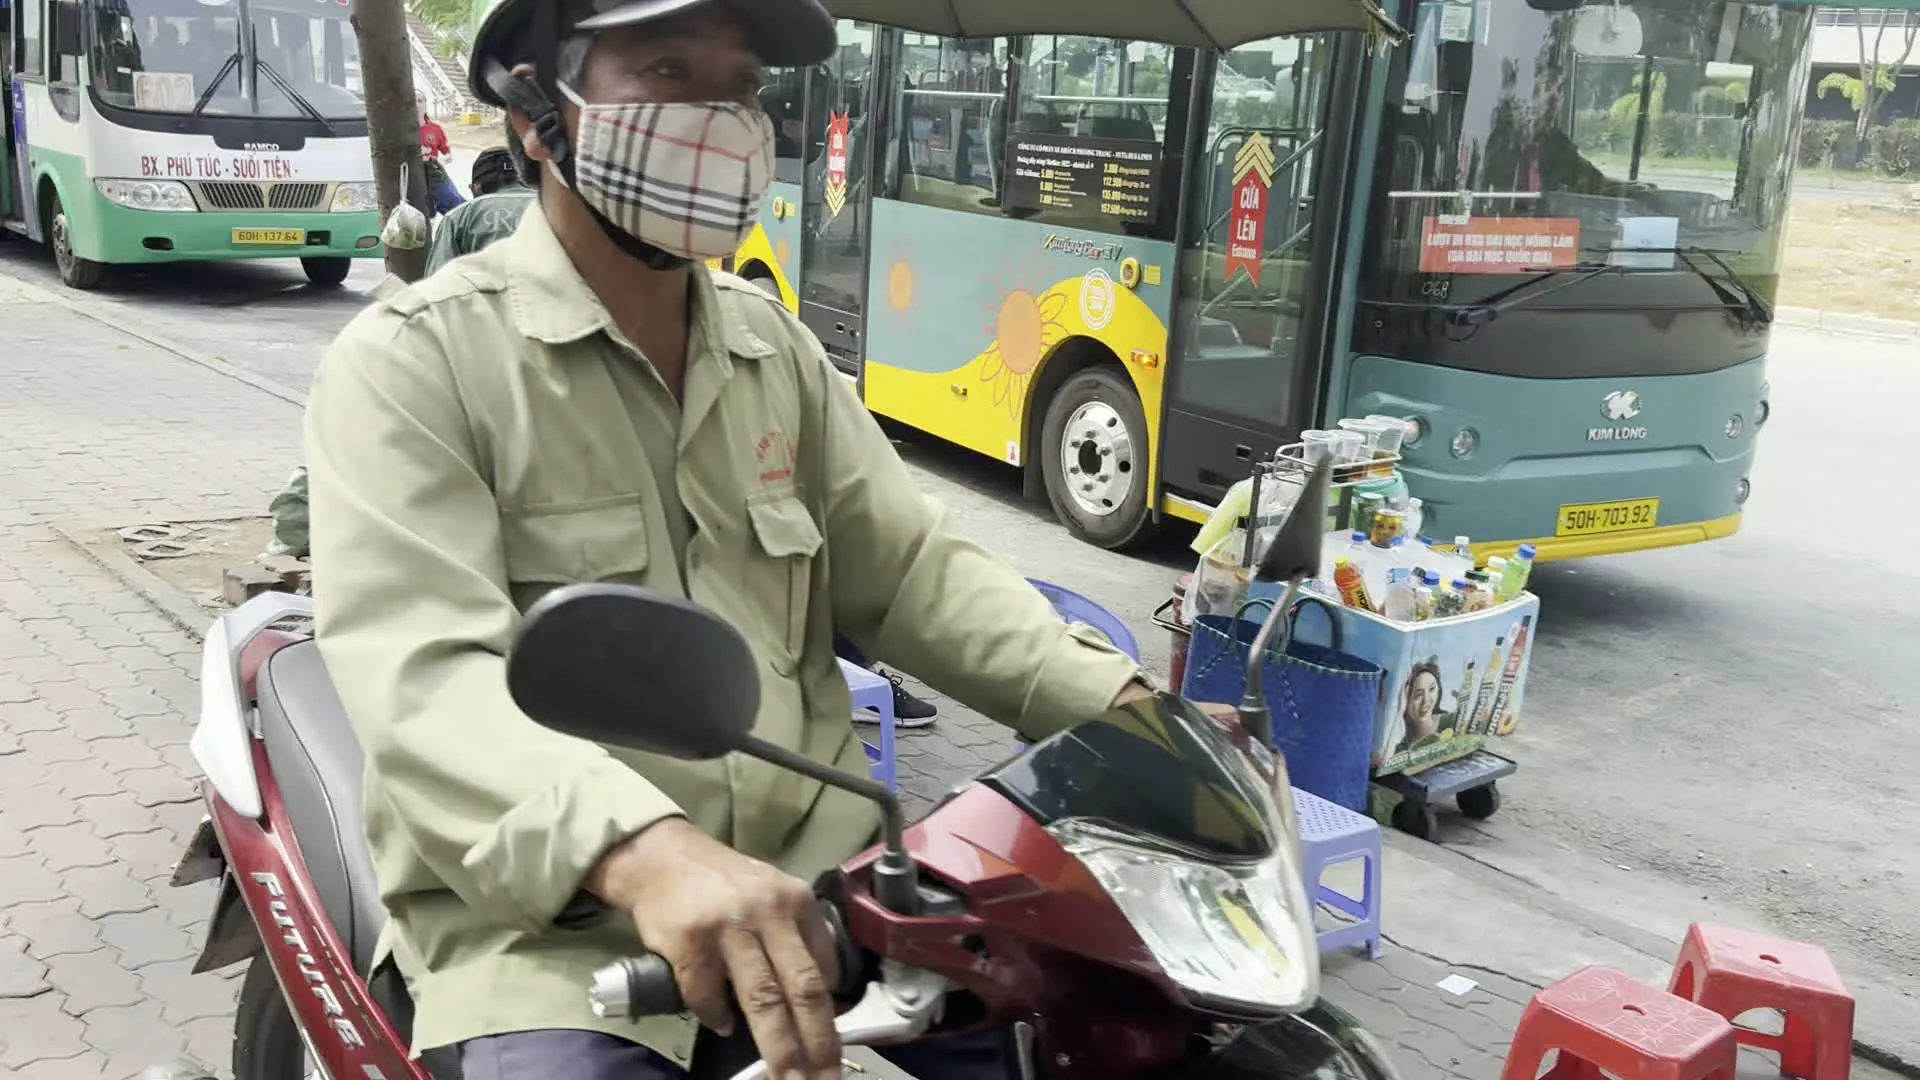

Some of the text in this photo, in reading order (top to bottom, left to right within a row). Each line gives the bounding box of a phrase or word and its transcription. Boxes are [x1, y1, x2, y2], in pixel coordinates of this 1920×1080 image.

[141, 156, 163, 177] BX.
[167, 153, 192, 177] PHÚ
[195, 153, 221, 178] TÚC
[1240, 180, 1260, 209] CỬA
[238, 230, 298, 241] 60H-137.64
[1236, 213, 1257, 241] LÊN
[1587, 427, 1648, 441] KIM LONG
[1565, 504, 1650, 530] 50H-703.92
[248, 871, 366, 1048] FUTURE
